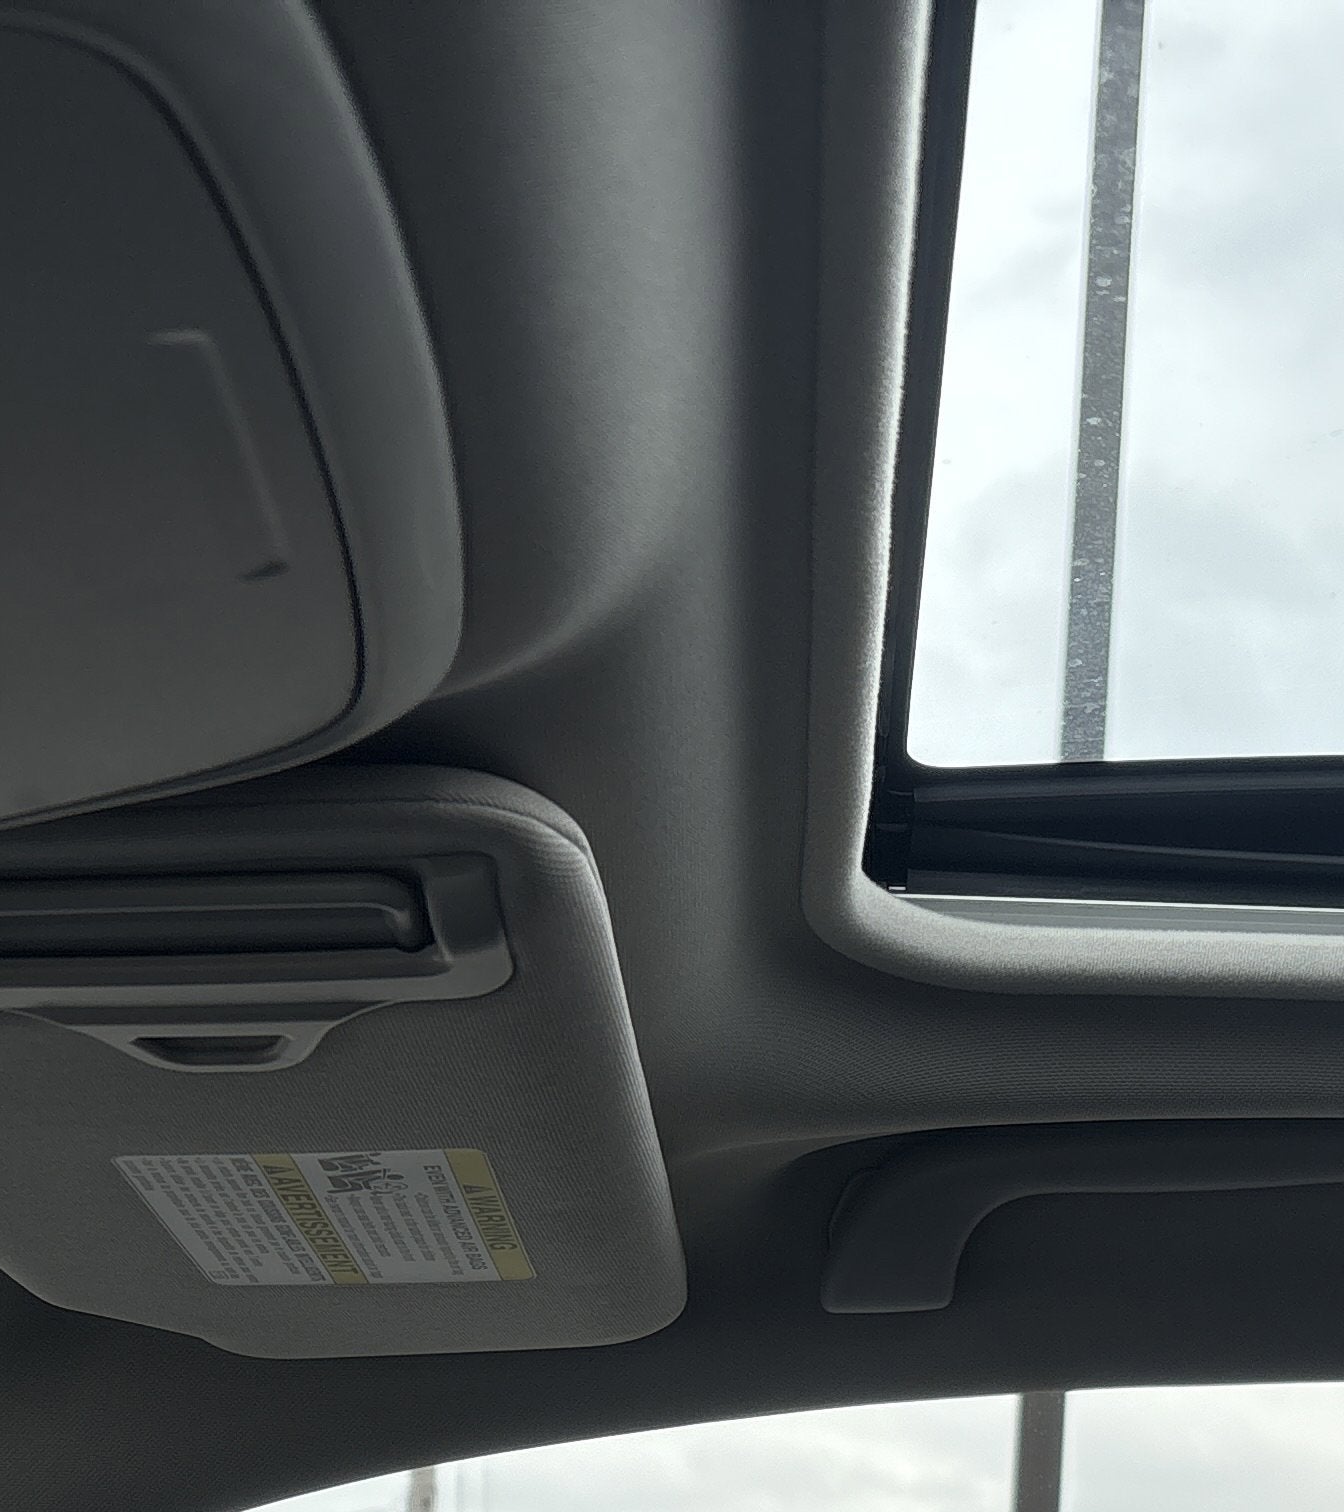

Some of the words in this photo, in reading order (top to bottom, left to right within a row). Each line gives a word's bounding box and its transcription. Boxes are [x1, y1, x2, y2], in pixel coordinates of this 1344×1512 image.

[423, 1165, 447, 1185] EVEN
[433, 1185, 455, 1204] WITH
[270, 1178, 359, 1274] AVERTISSEMENT
[442, 1204, 473, 1241] ADVANCED
[467, 1196, 518, 1251] WARNING
[465, 1253, 489, 1270] BAGS
